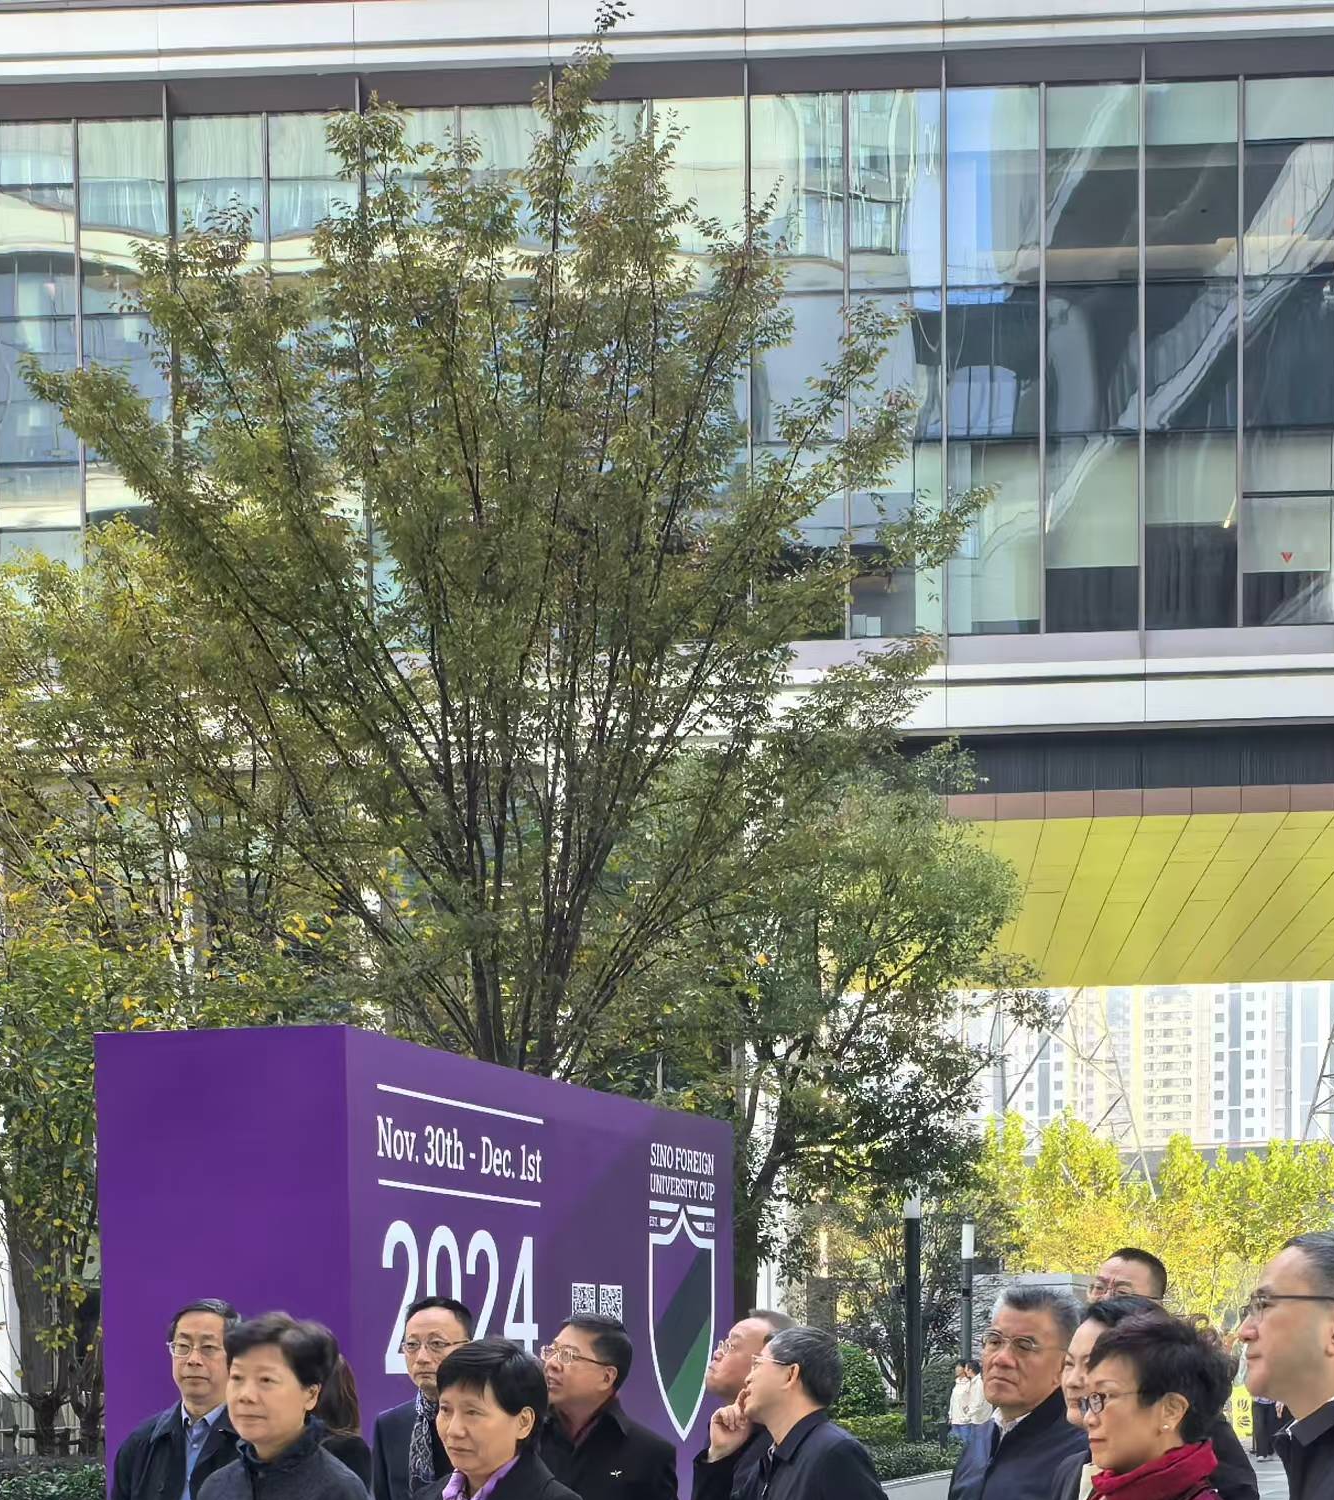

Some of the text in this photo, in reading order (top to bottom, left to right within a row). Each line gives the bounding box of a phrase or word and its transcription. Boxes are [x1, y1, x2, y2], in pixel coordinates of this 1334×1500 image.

[376, 1115, 419, 1163] Nov.
[424, 1125, 465, 1170] 30th
[480, 1136, 515, 1179] Dec.
[519, 1144, 542, 1183] 1st
[650, 1142, 715, 1176] SINO FOREIGN
[650, 1173, 715, 1202] UNIVERSITY CUP
